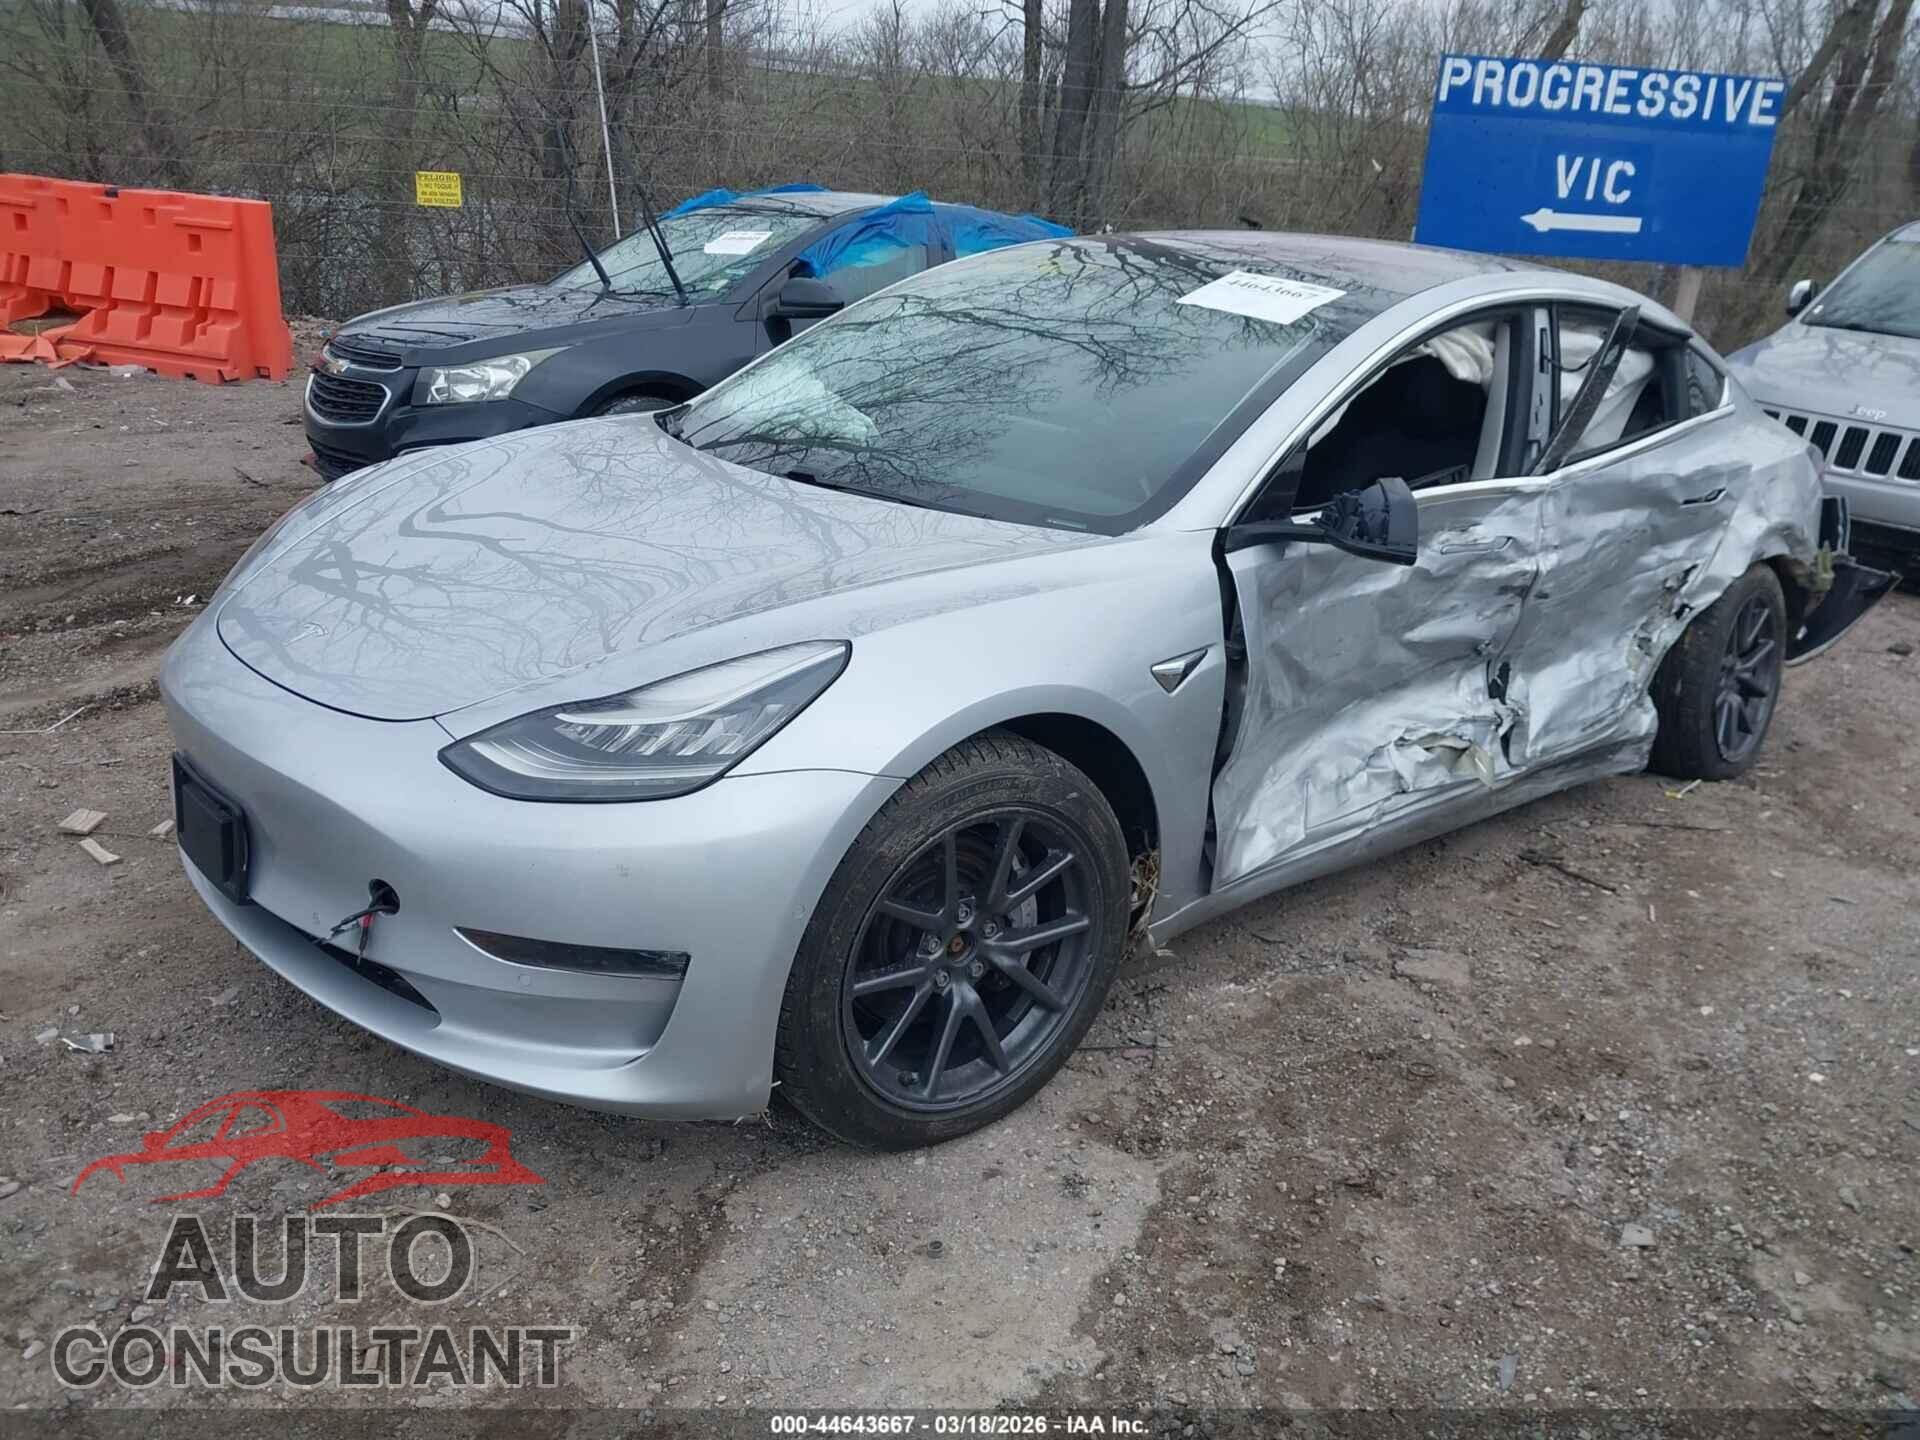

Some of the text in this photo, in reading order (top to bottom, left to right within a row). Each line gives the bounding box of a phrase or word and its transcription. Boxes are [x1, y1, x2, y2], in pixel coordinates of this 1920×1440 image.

[1439, 57, 1785, 126] PROGRESSIVE
[1556, 154, 1636, 204] VIC
[1848, 404, 1887, 421] Jeep
